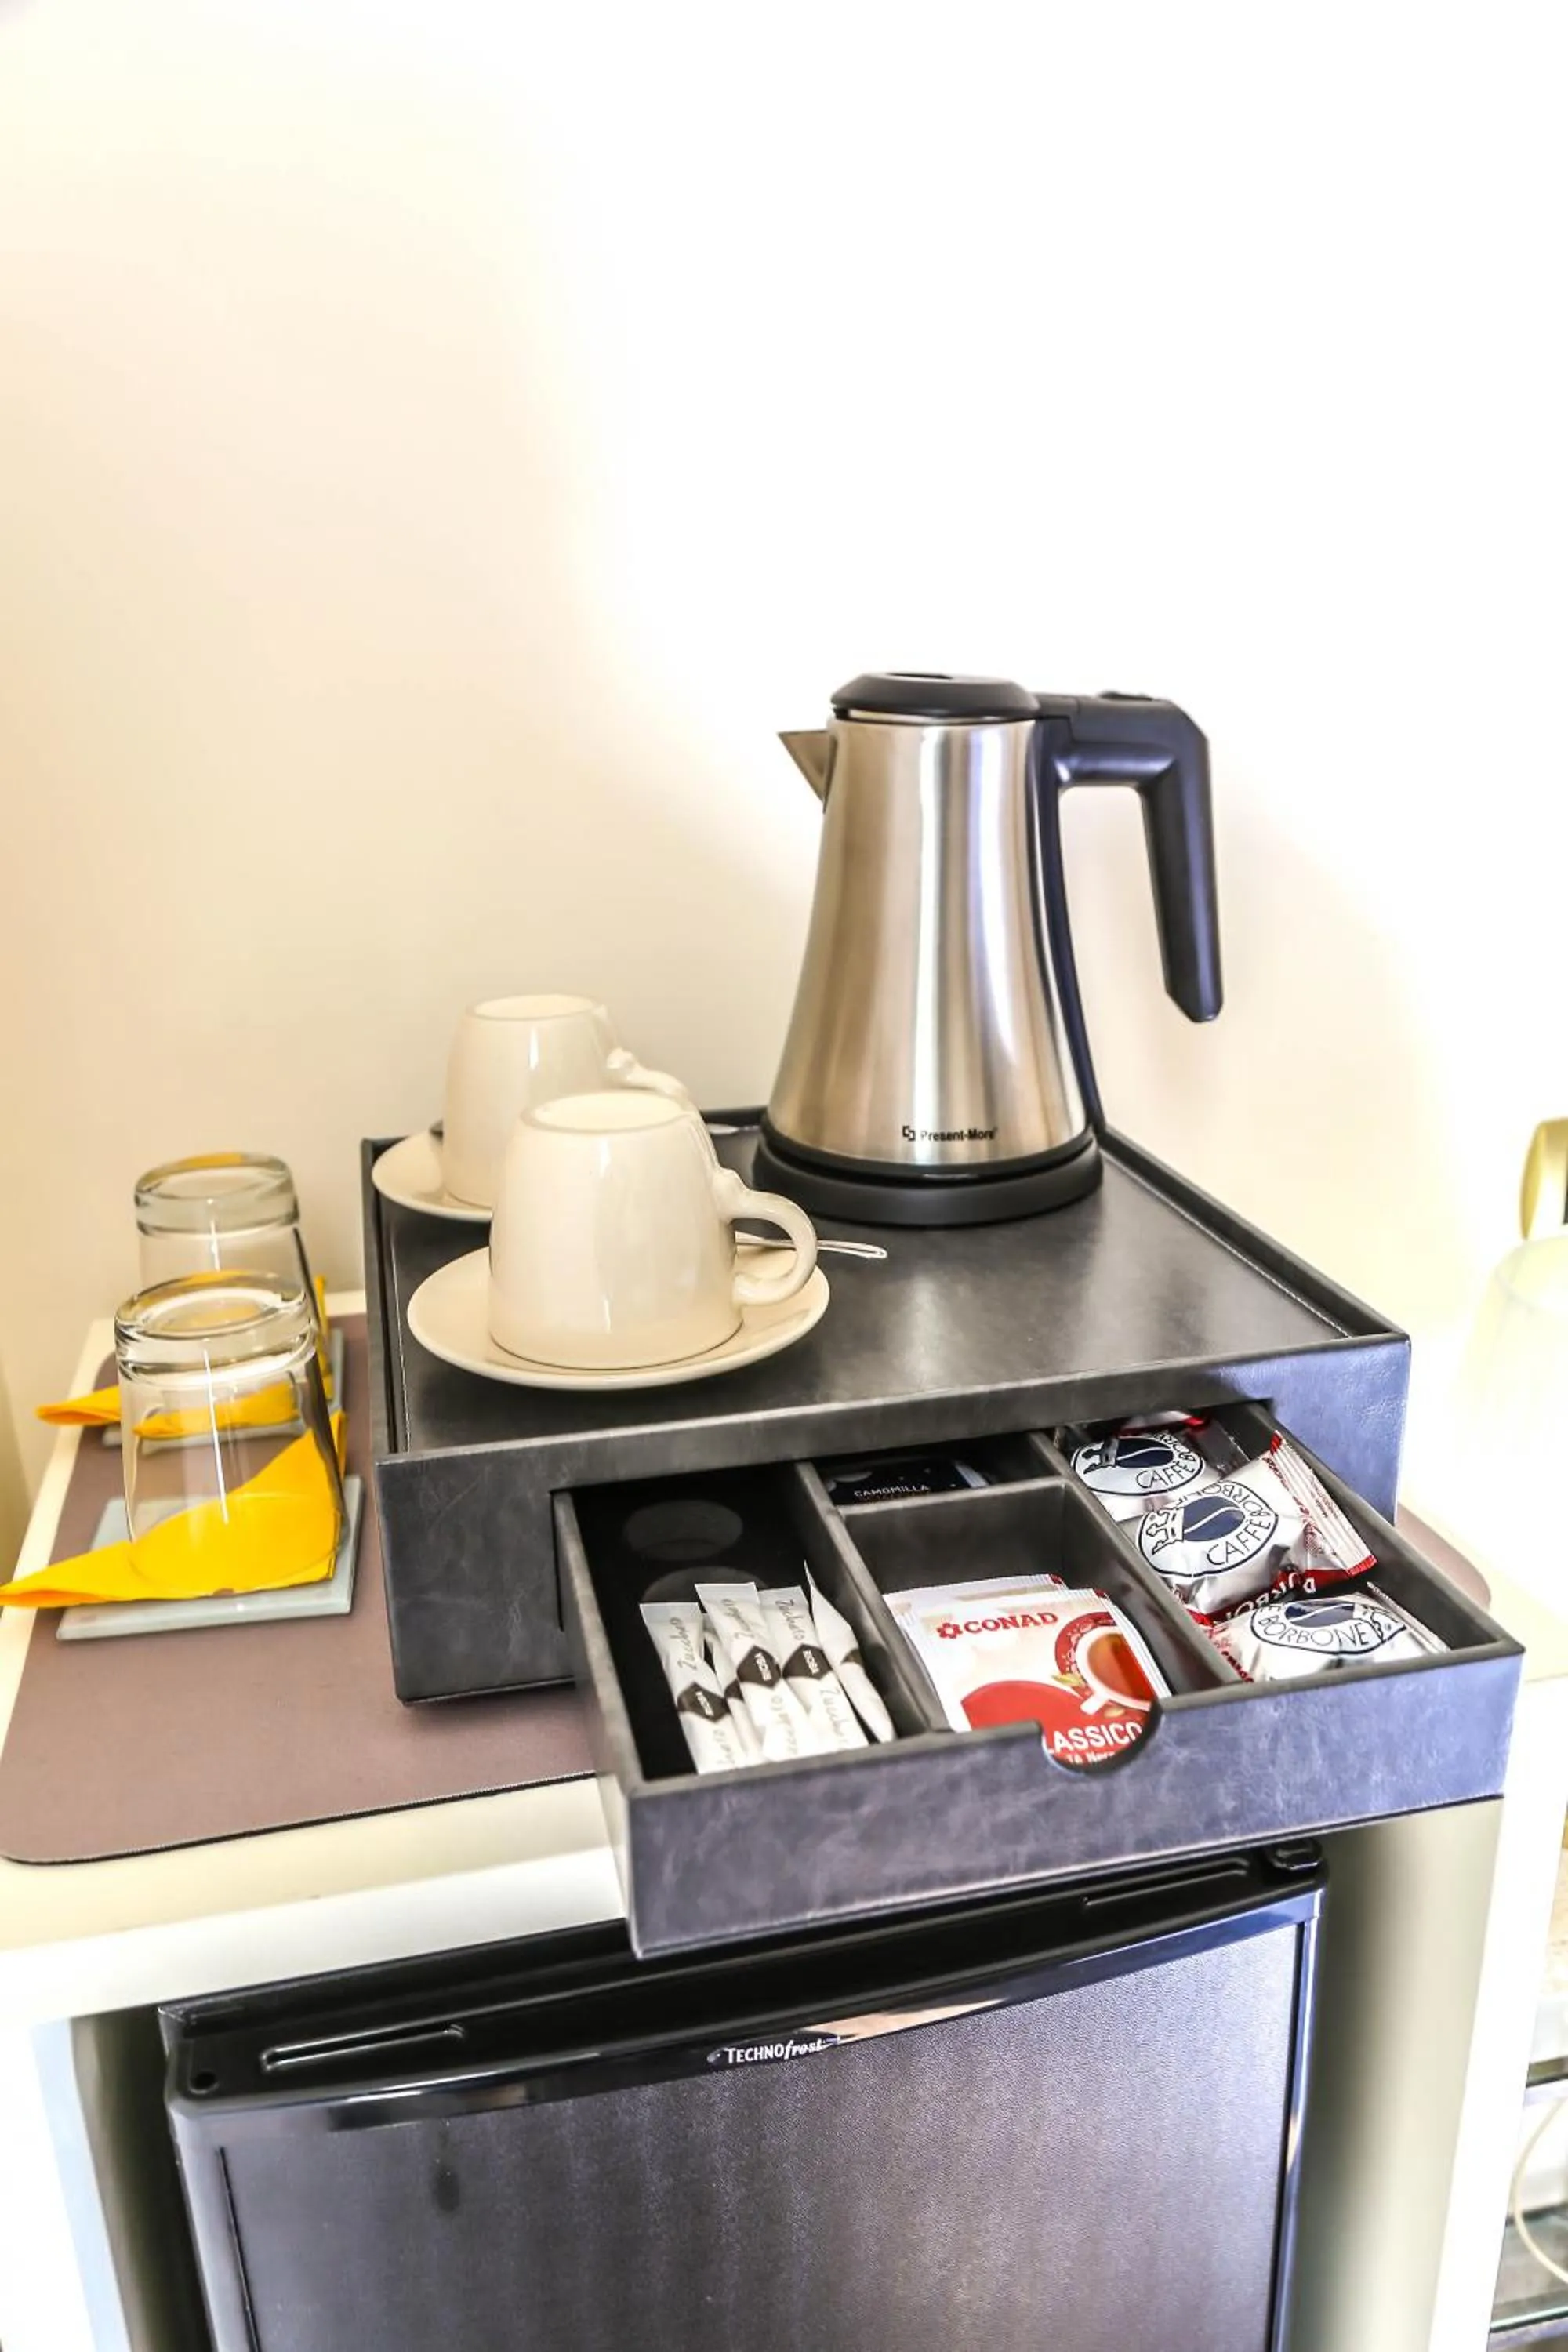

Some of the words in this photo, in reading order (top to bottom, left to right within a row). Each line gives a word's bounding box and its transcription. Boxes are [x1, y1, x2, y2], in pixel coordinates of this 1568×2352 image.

[920, 1127, 996, 1142] Present-More
[854, 1484, 930, 1497] CAMOMILLA
[964, 1612, 1059, 1634] CONAD
[1258, 1614, 1370, 1647] BORBONE
[725, 2038, 823, 2064] TECHNOfrost
